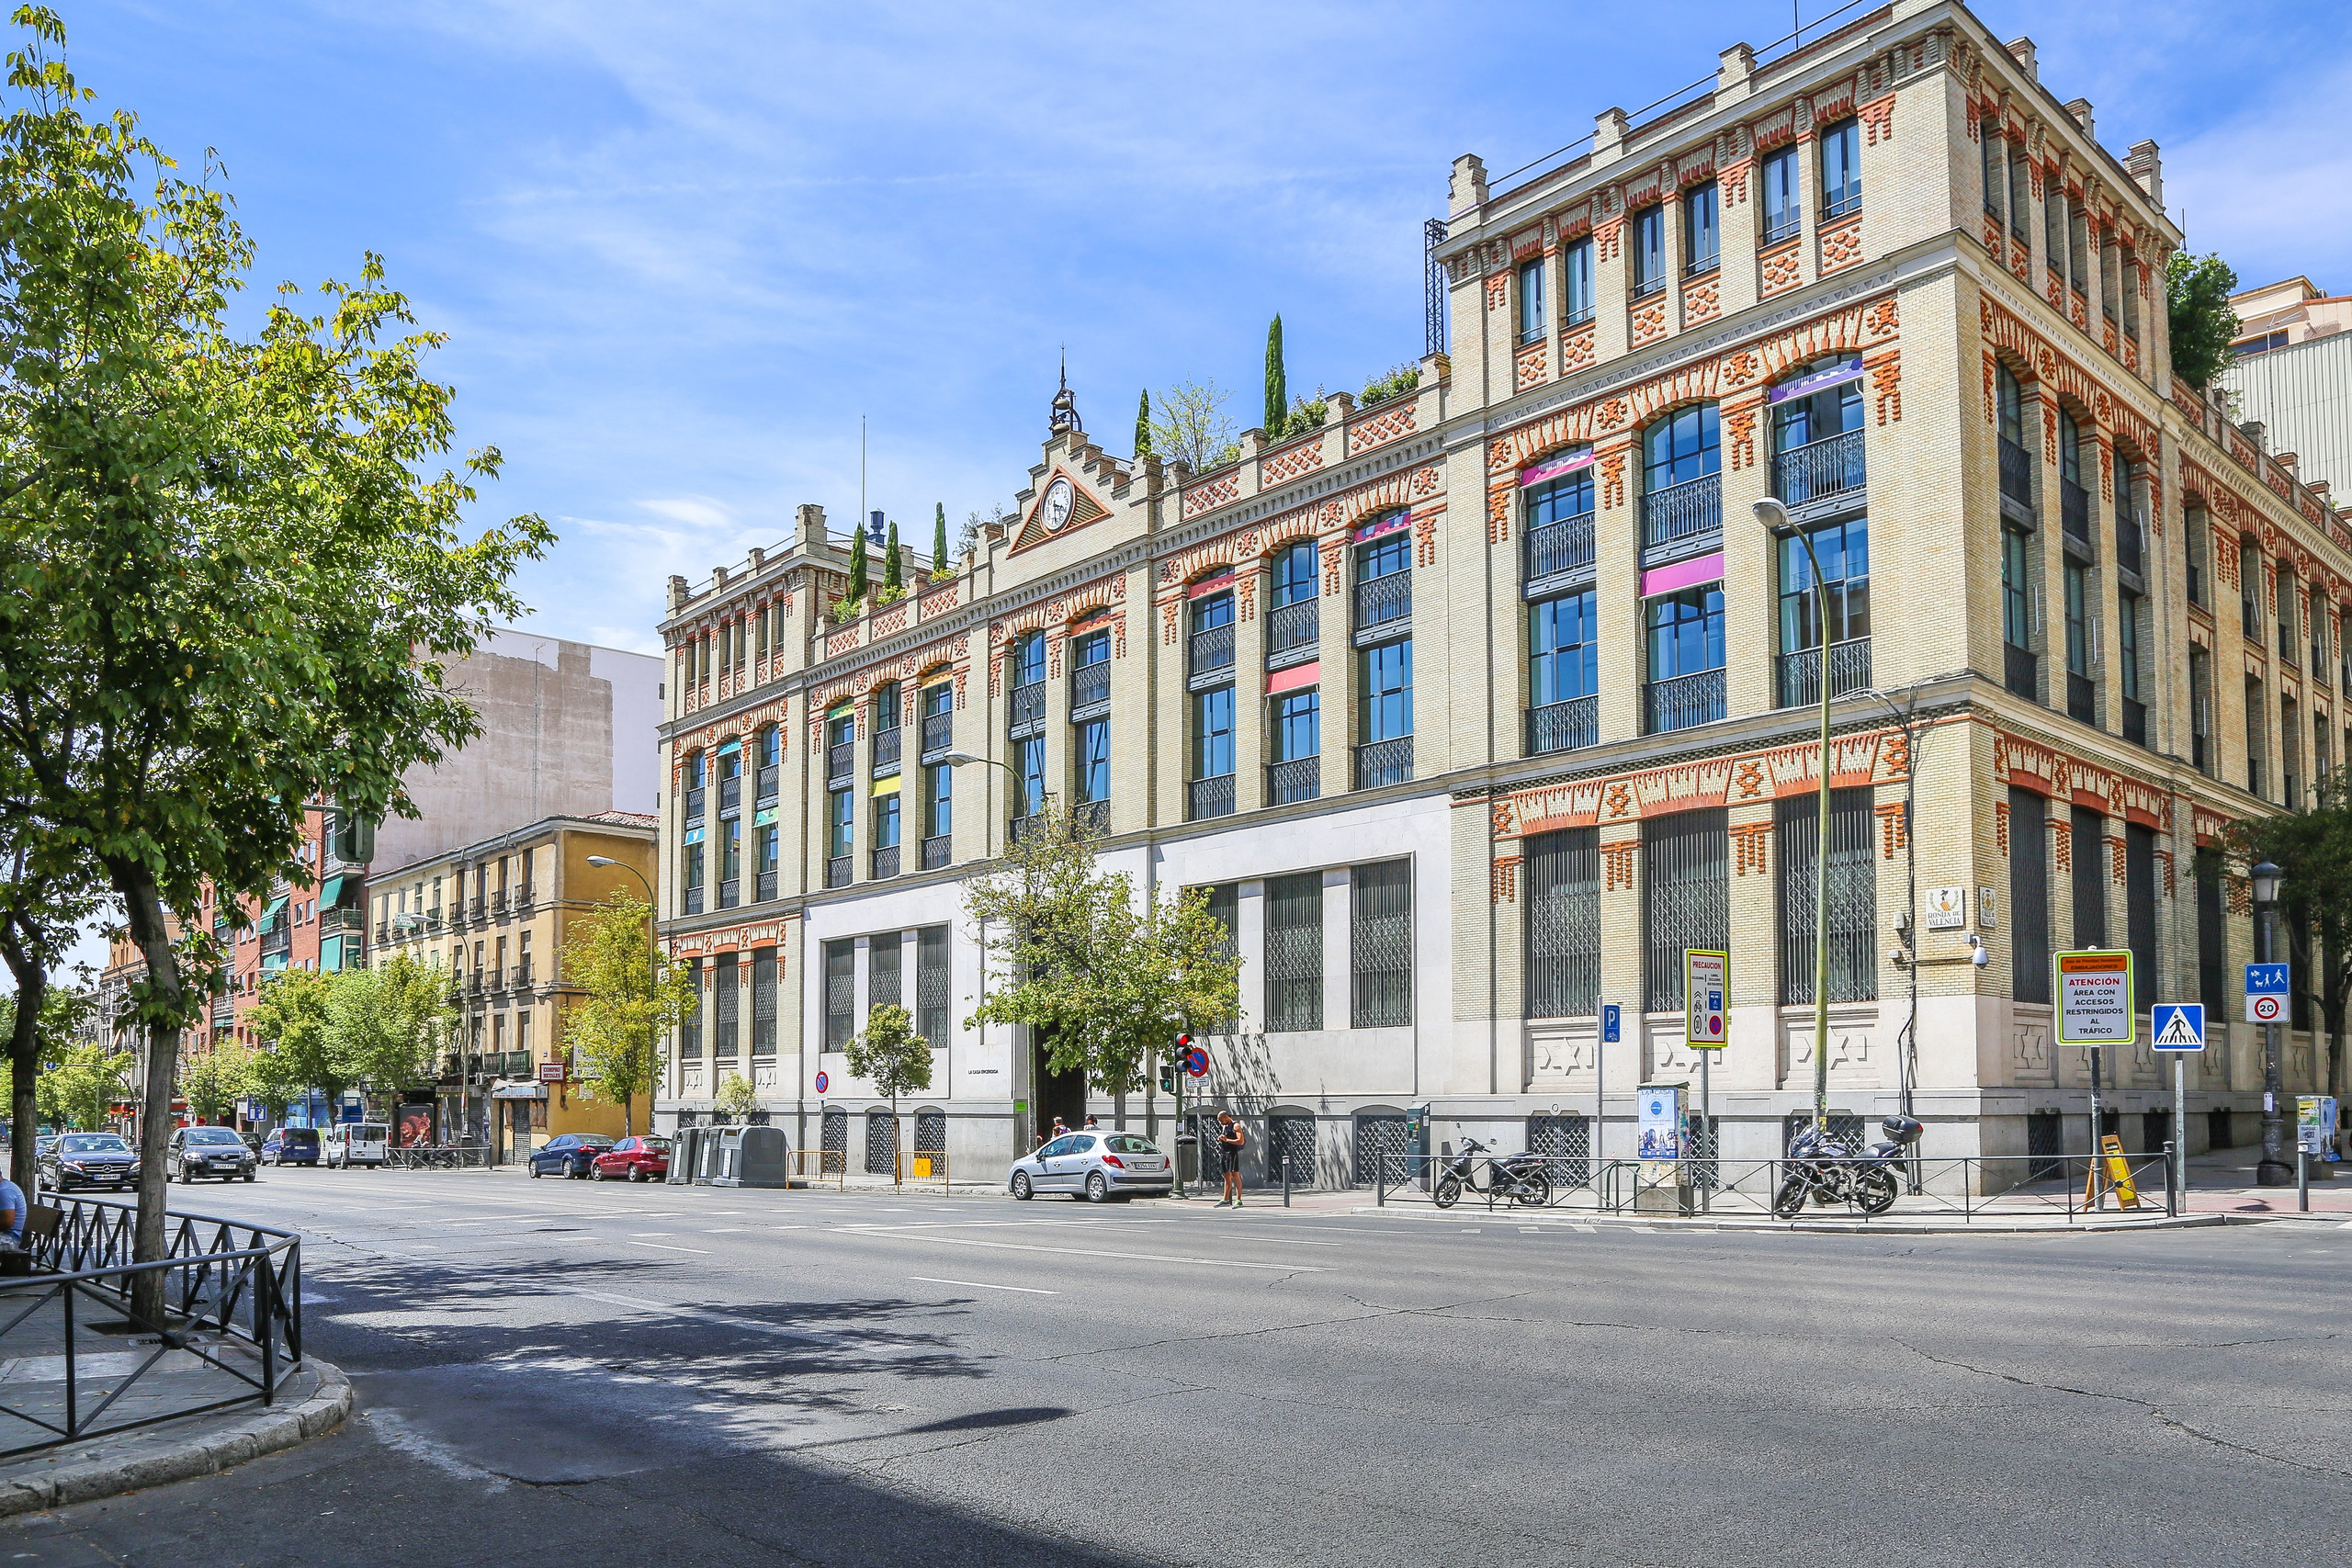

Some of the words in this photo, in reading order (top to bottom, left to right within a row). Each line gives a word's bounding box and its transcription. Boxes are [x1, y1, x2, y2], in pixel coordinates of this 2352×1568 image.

[1928, 917, 1961, 926] VALENCIA
[1692, 961, 1722, 970] PRECAUCION
[2068, 976, 2120, 986] ATENCIÓN
[2259, 1004, 2274, 1012] 20
[1608, 1010, 1616, 1027] P
